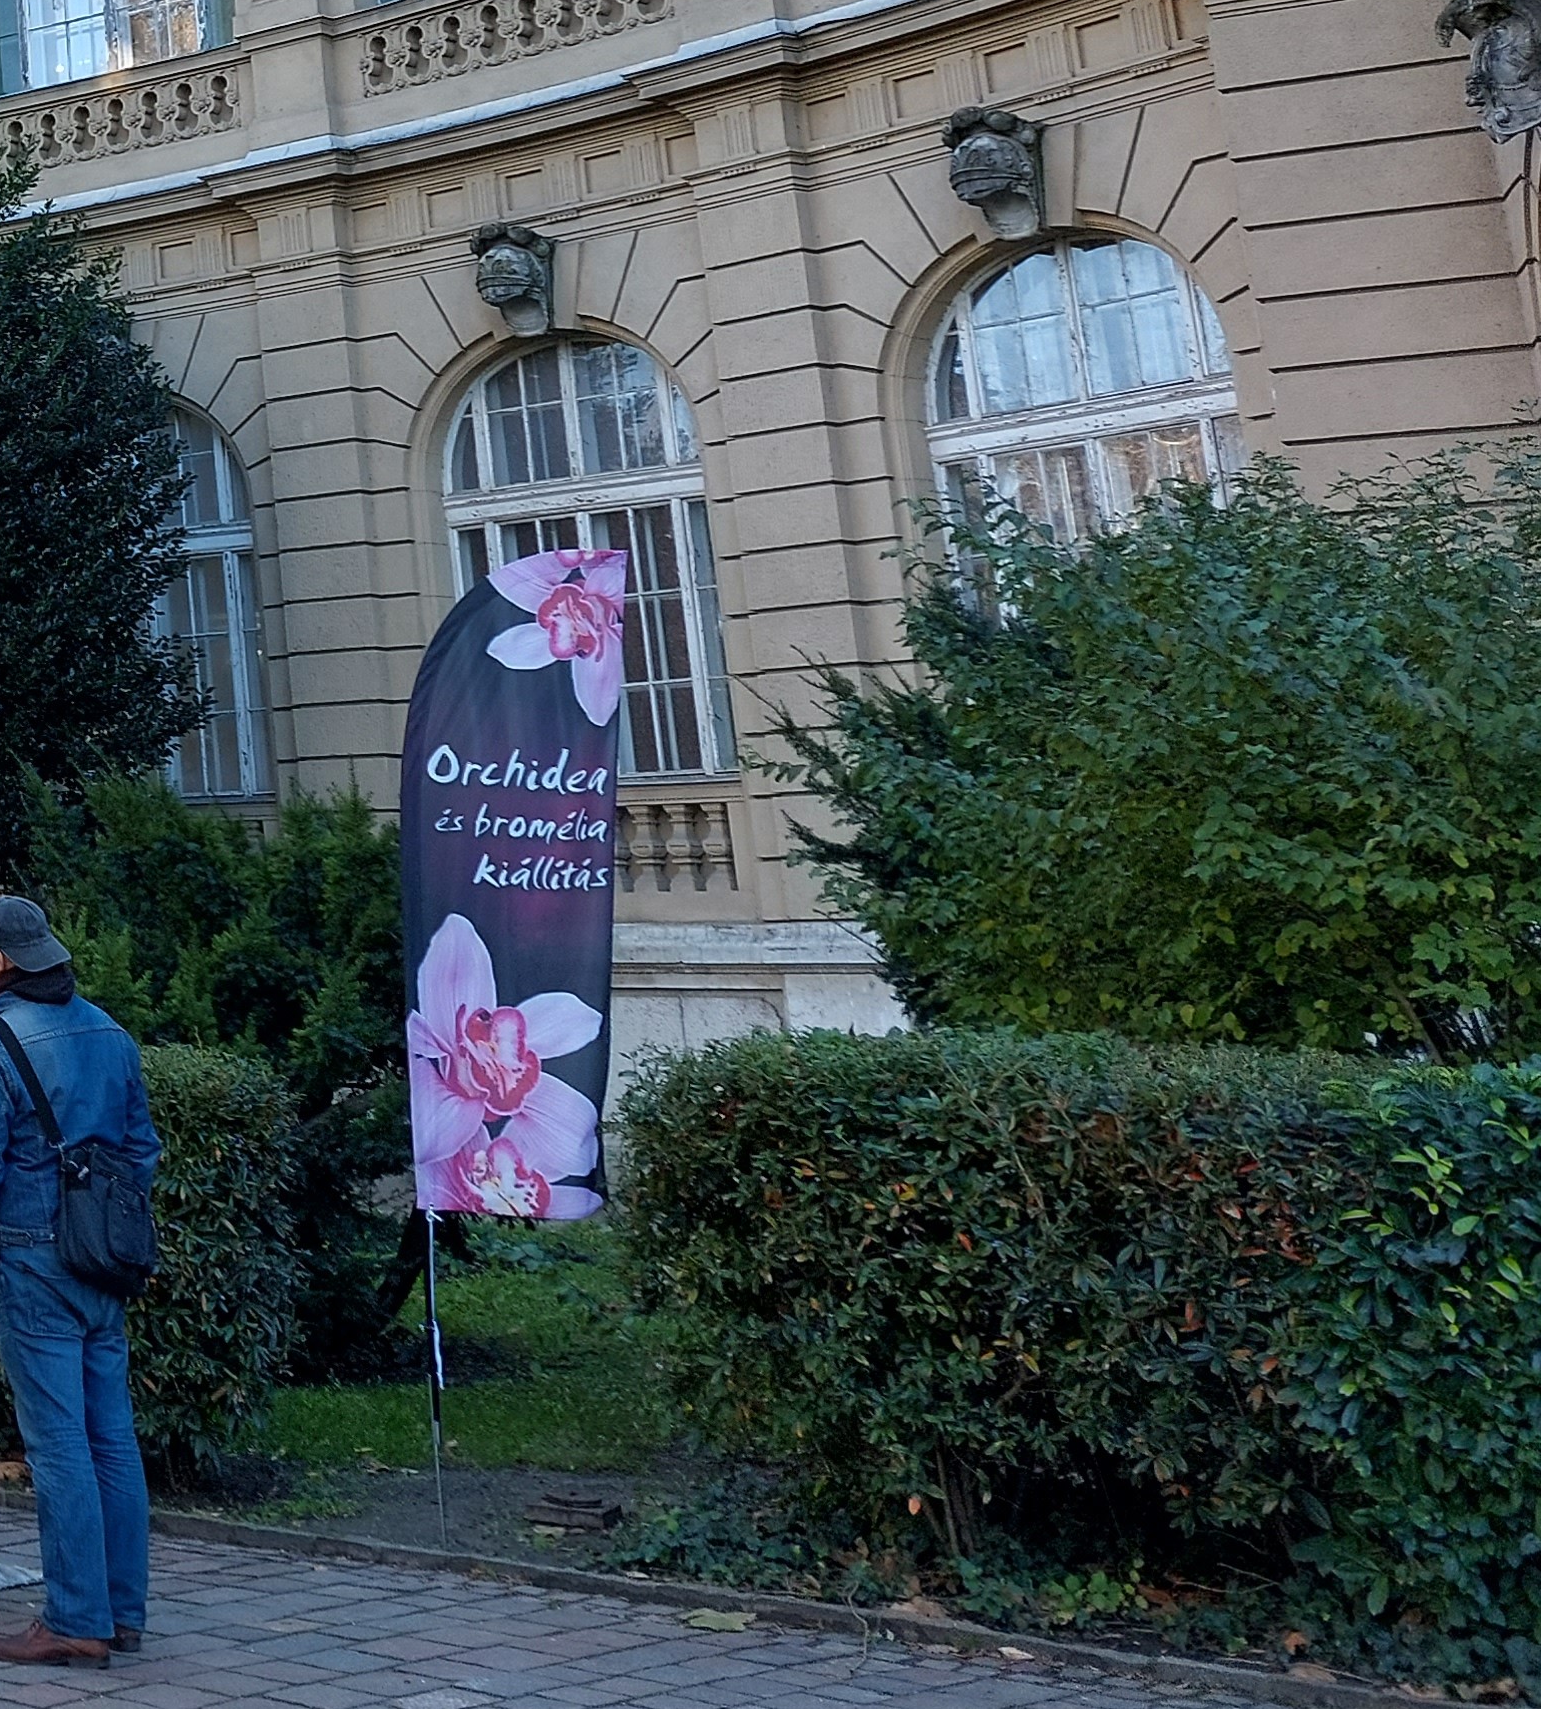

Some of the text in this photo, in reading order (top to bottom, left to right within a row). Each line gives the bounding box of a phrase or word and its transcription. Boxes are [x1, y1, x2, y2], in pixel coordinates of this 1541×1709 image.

[427, 744, 609, 796] Orchidea
[434, 802, 609, 845] és bromélia
[473, 853, 609, 892] kiállítás
